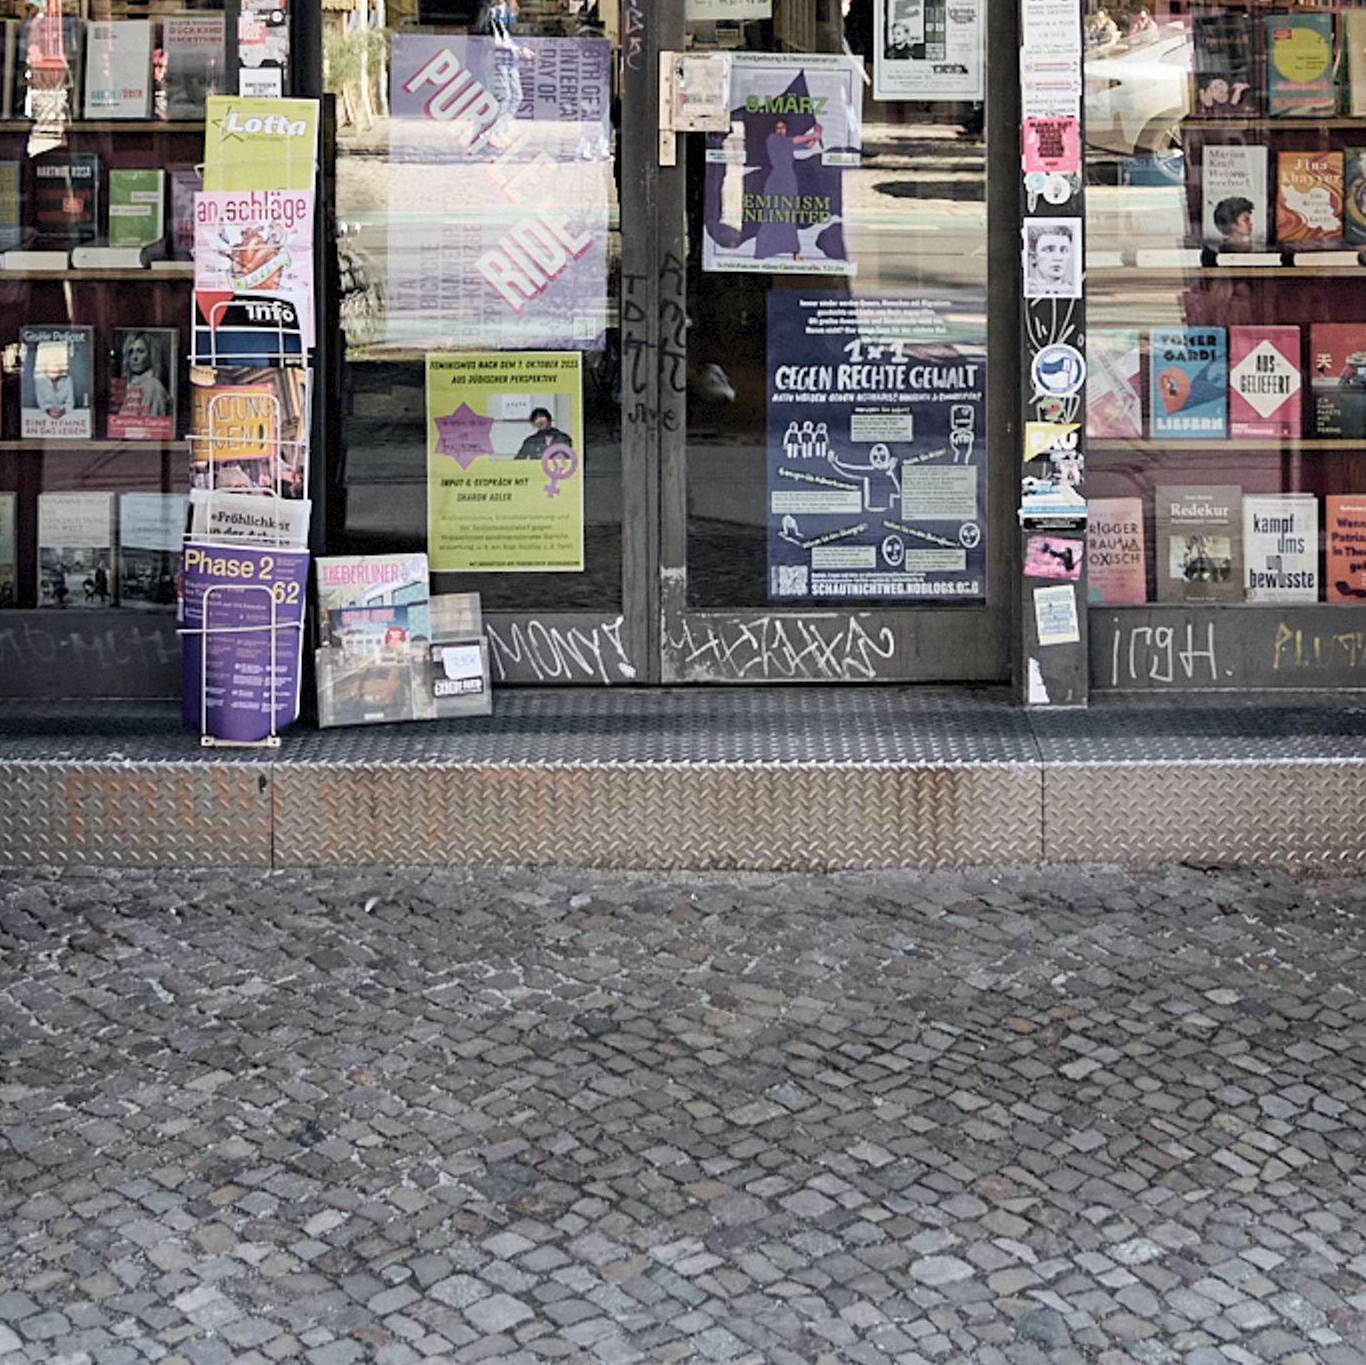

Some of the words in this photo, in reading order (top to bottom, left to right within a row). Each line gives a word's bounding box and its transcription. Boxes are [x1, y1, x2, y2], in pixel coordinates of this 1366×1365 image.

[538, 47, 557, 74] DAY
[226, 112, 308, 136] Lotta
[1209, 149, 1246, 159] Marion
[1294, 158, 1328, 171] Jina
[196, 191, 308, 229] an.schläge
[742, 194, 831, 211] EMINISM
[742, 208, 832, 226] NLIMITED
[474, 208, 595, 315] RIDE
[1163, 348, 1217, 361] GARDI
[1255, 354, 1281, 373] AUS-
[478, 360, 499, 370] NACH
[499, 360, 516, 370] DEM
[525, 360, 559, 370] OKTOBER
[451, 374, 467, 385] AUS
[468, 373, 509, 385] JÜDISCHER
[510, 373, 558, 385] PERSPEKTIVE
[774, 364, 833, 392] GEGEN
[836, 363, 907, 391] RECHTE
[909, 364, 979, 389] GEWALT
[1239, 373, 1291, 395] GELIEFERT
[1156, 417, 1224, 431] LIEFERN
[514, 477, 529, 487] MIT
[489, 493, 513, 502] ADLER
[1169, 502, 1230, 518] Redekur
[1252, 513, 1295, 535] kampf
[1335, 517, 1366, 529] Wenn
[1277, 534, 1305, 555] ums
[184, 549, 256, 578] Phase
[259, 556, 275, 581] 2
[272, 581, 301, 605] 62
